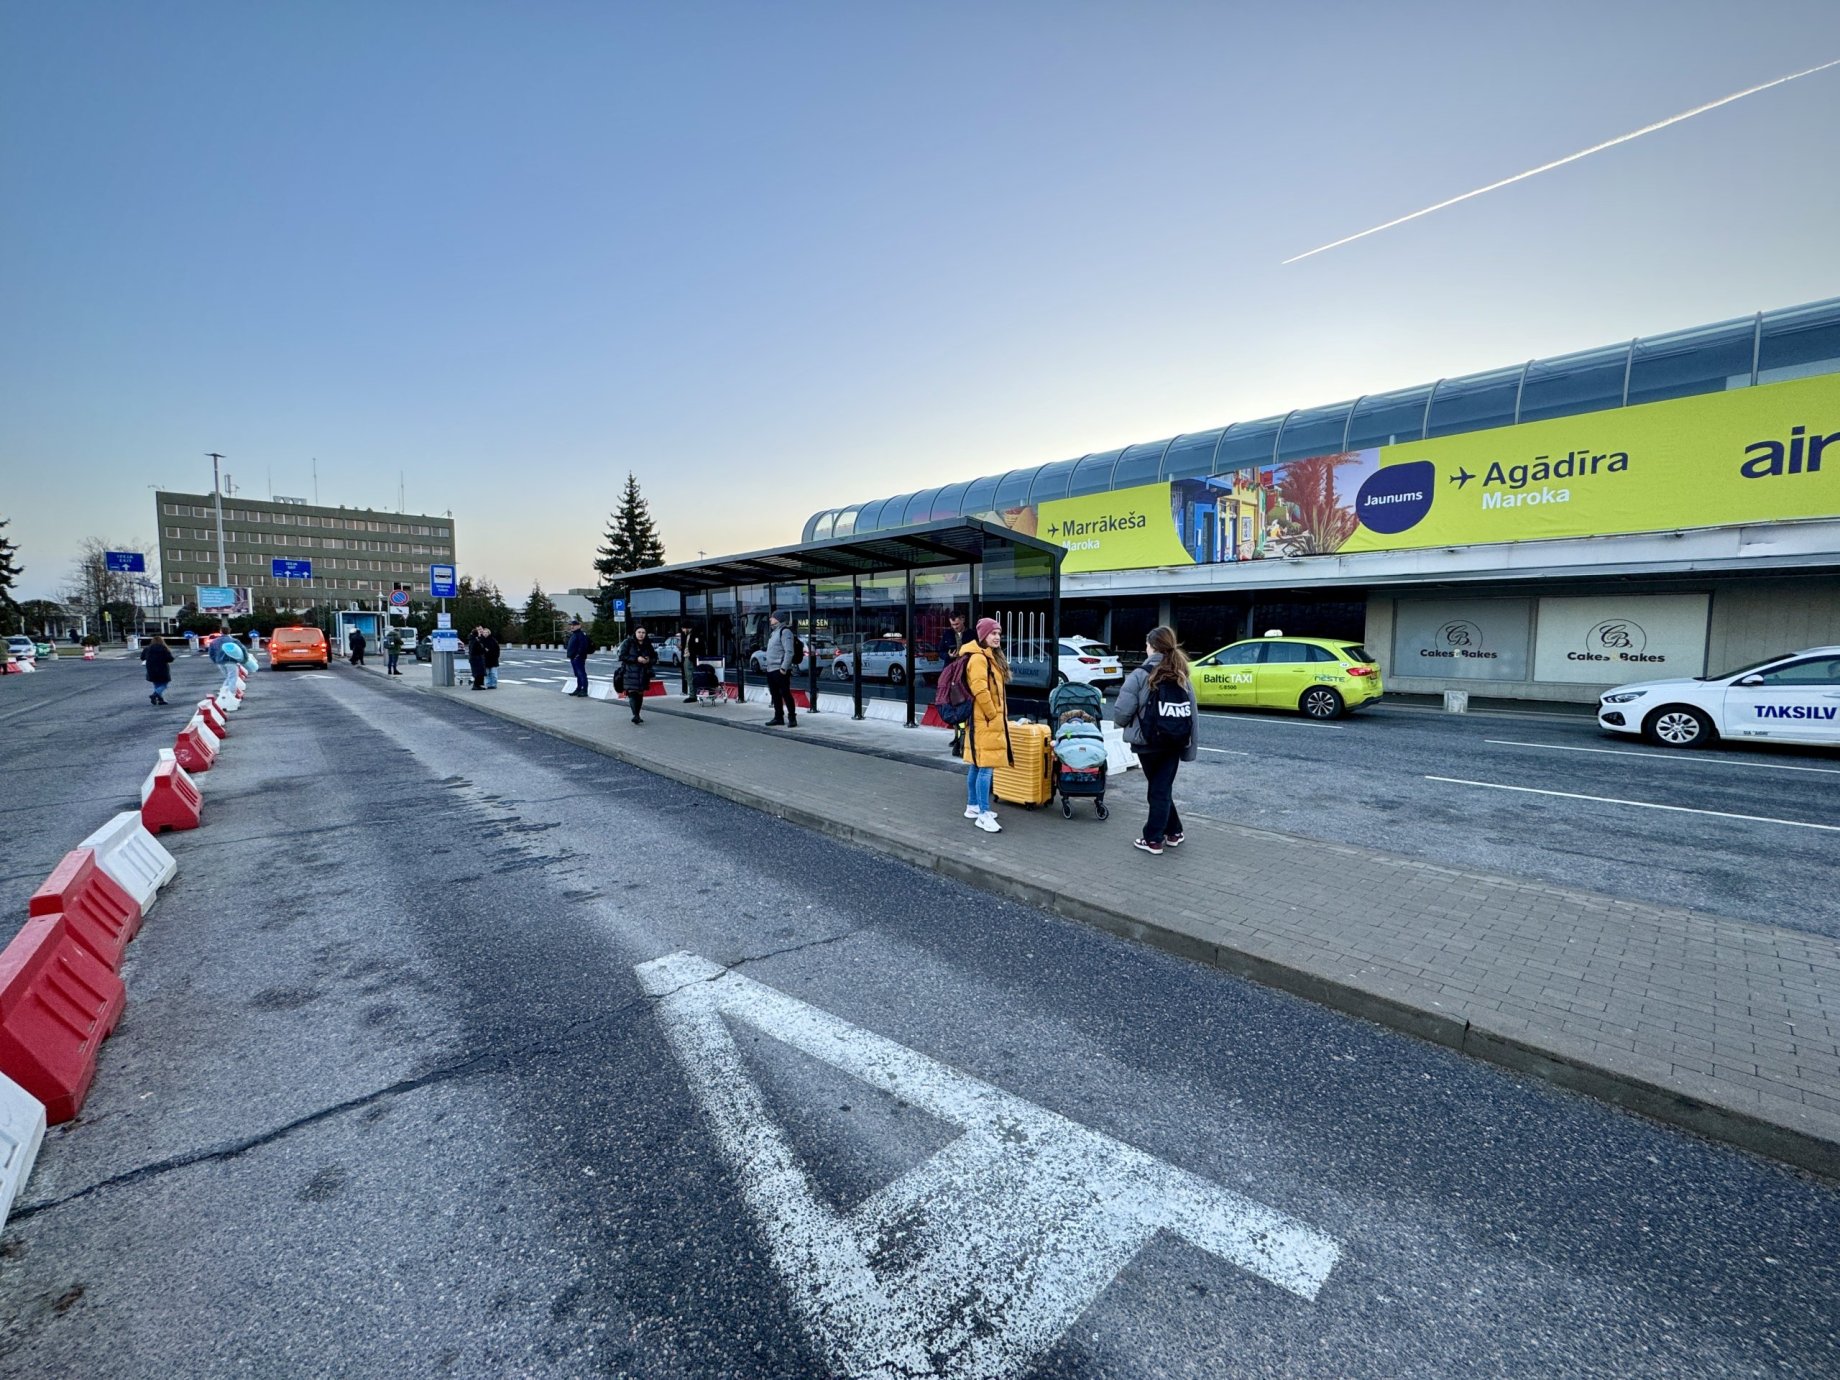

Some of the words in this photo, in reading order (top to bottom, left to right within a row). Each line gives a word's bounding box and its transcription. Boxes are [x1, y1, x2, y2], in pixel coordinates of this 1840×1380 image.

[1482, 449, 1629, 489] Agādīra
[1364, 490, 1423, 507] Jaunums
[1481, 485, 1571, 510] Maroka
[1062, 510, 1146, 537] Marrākeša
[615, 600, 623, 610] P
[798, 618, 829, 627] NARSEN
[1420, 648, 1454, 658] Cakes
[1158, 700, 1191, 718] VANS
